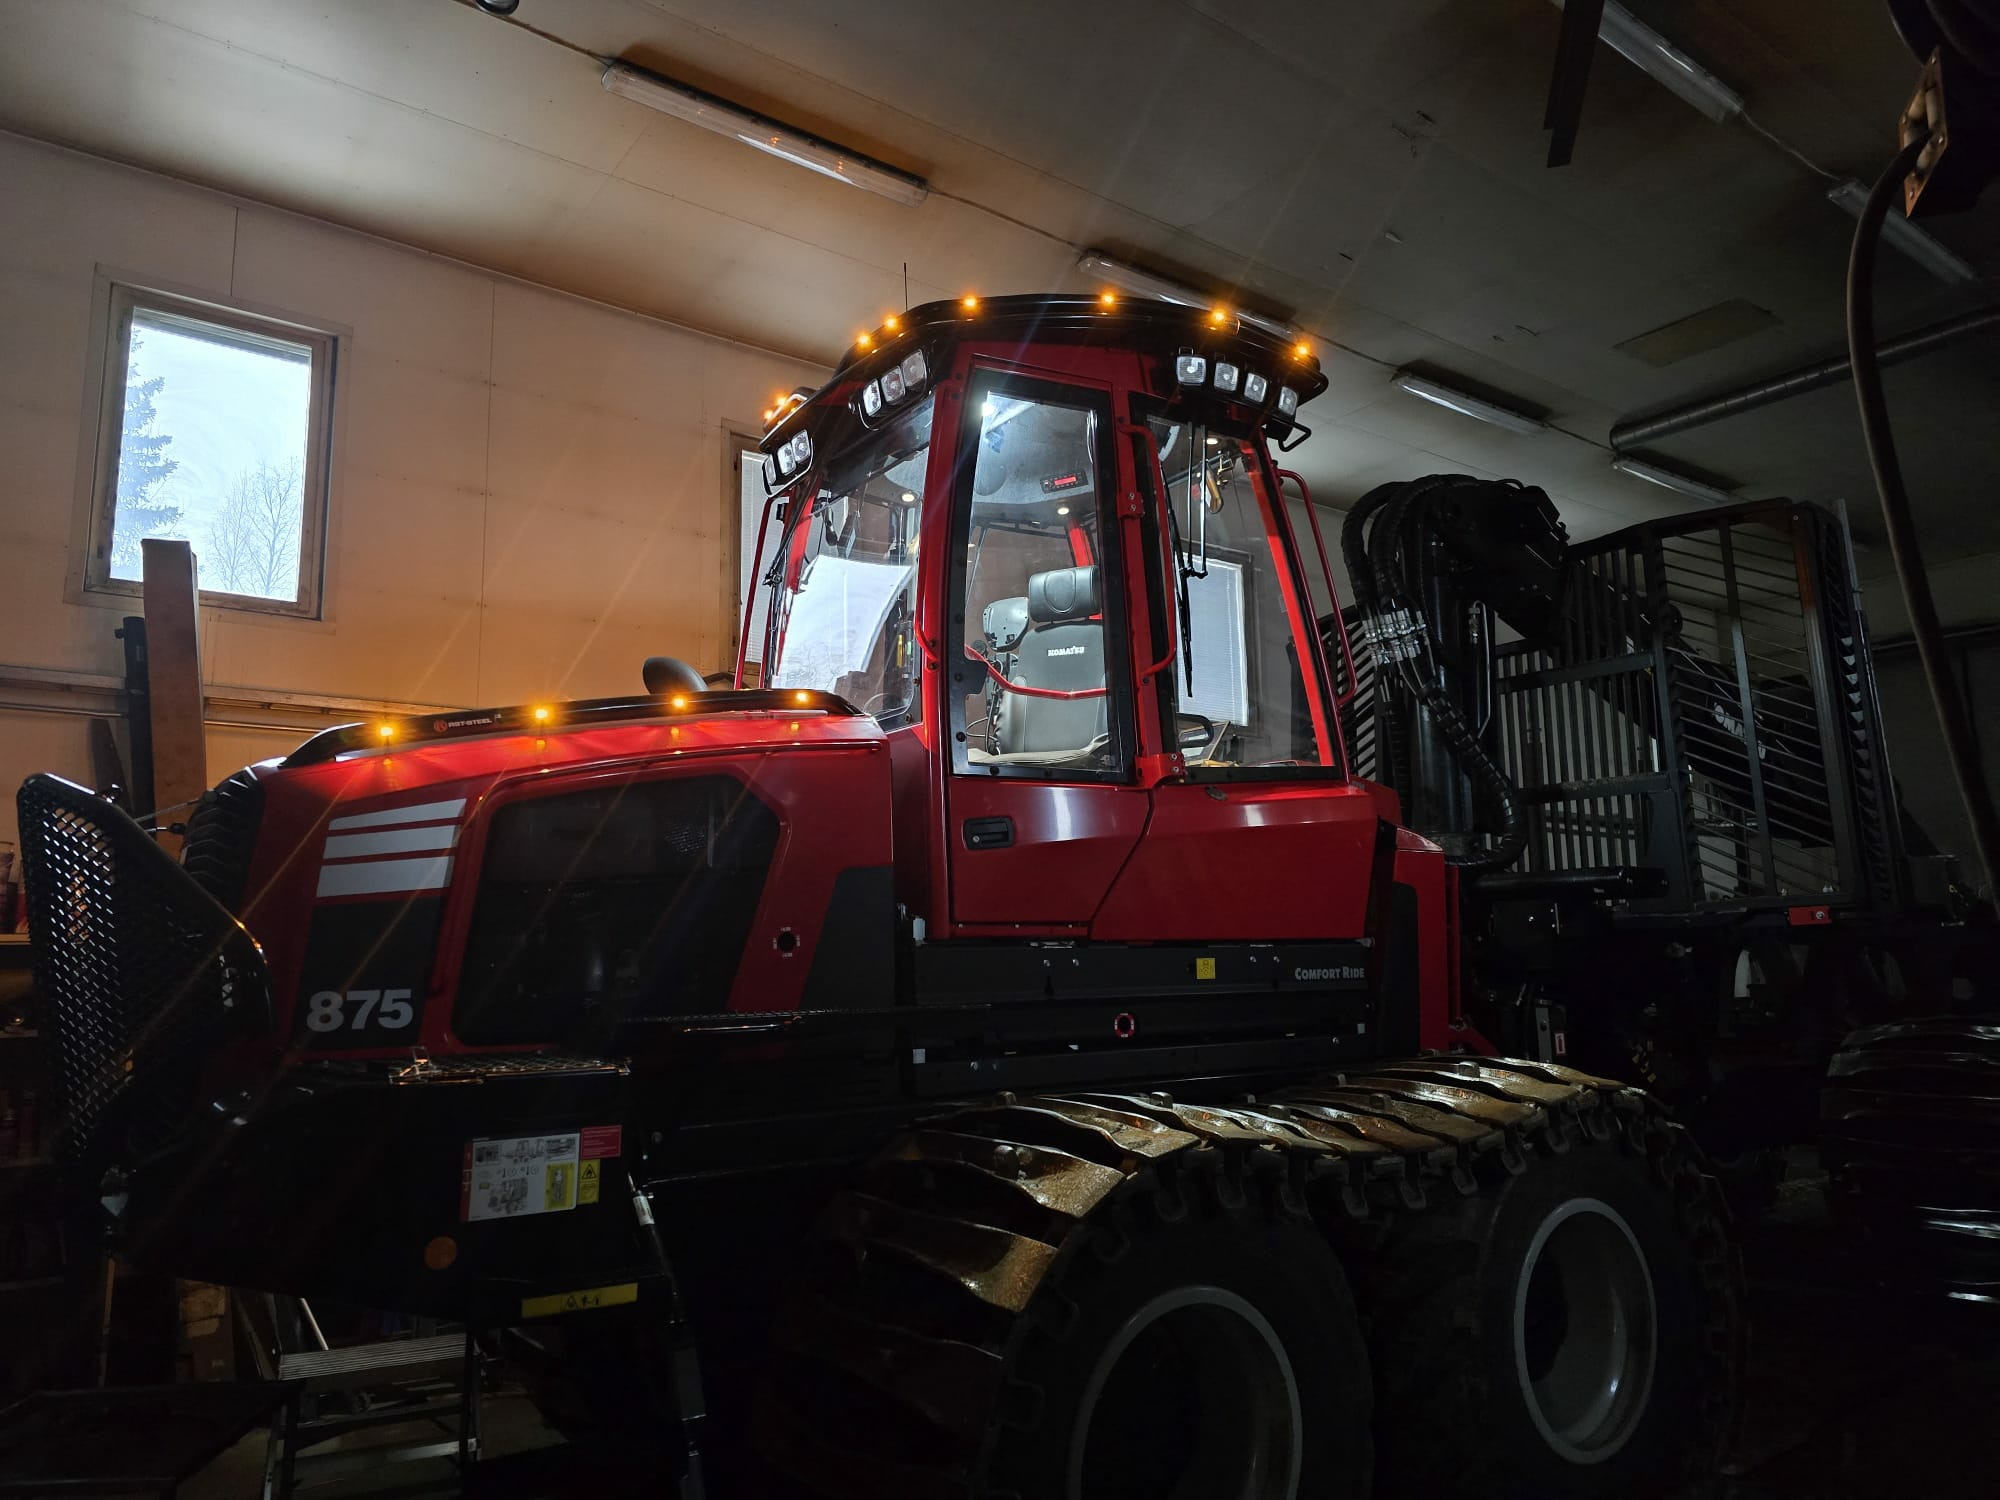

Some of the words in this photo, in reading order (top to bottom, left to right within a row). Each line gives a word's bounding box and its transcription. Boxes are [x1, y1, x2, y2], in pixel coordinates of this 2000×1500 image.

[1295, 967, 1341, 981] COMFORT
[1342, 965, 1366, 980] RIDE
[306, 988, 414, 1033] 875
